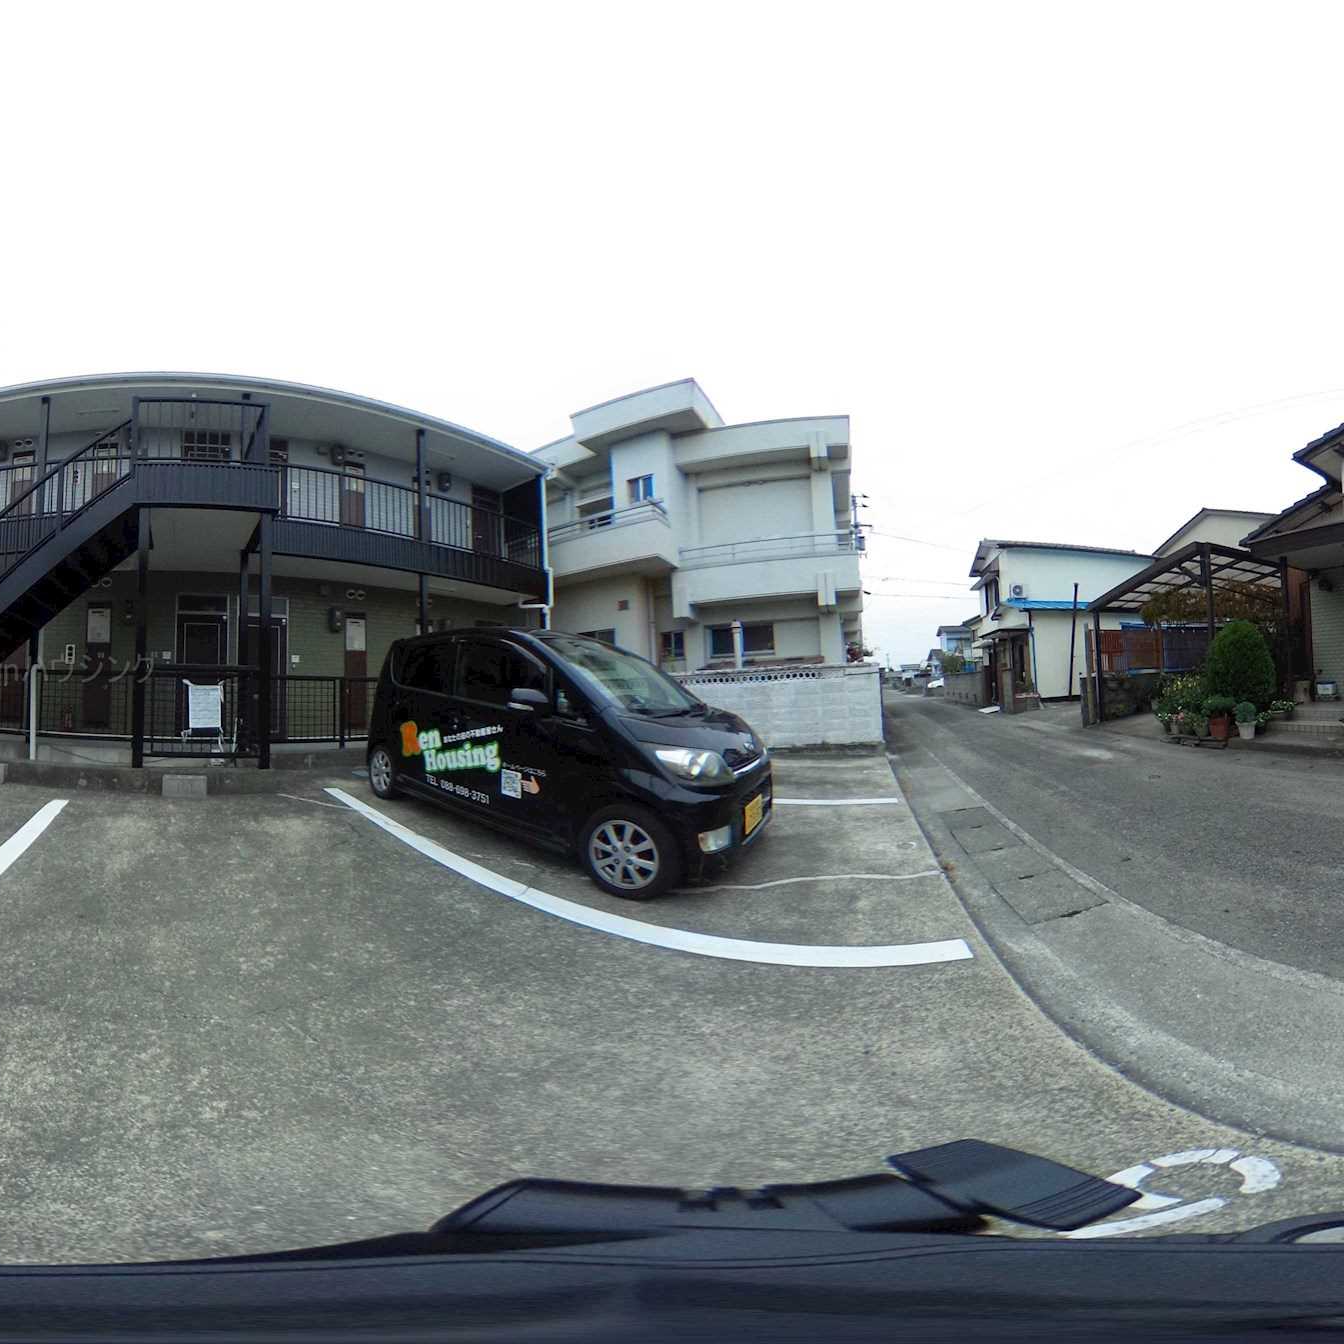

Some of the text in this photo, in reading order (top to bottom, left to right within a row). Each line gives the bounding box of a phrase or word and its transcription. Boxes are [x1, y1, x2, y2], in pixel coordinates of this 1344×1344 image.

[401, 721, 441, 756] Ren
[423, 741, 501, 772] Housing
[426, 775, 439, 786] TEL
